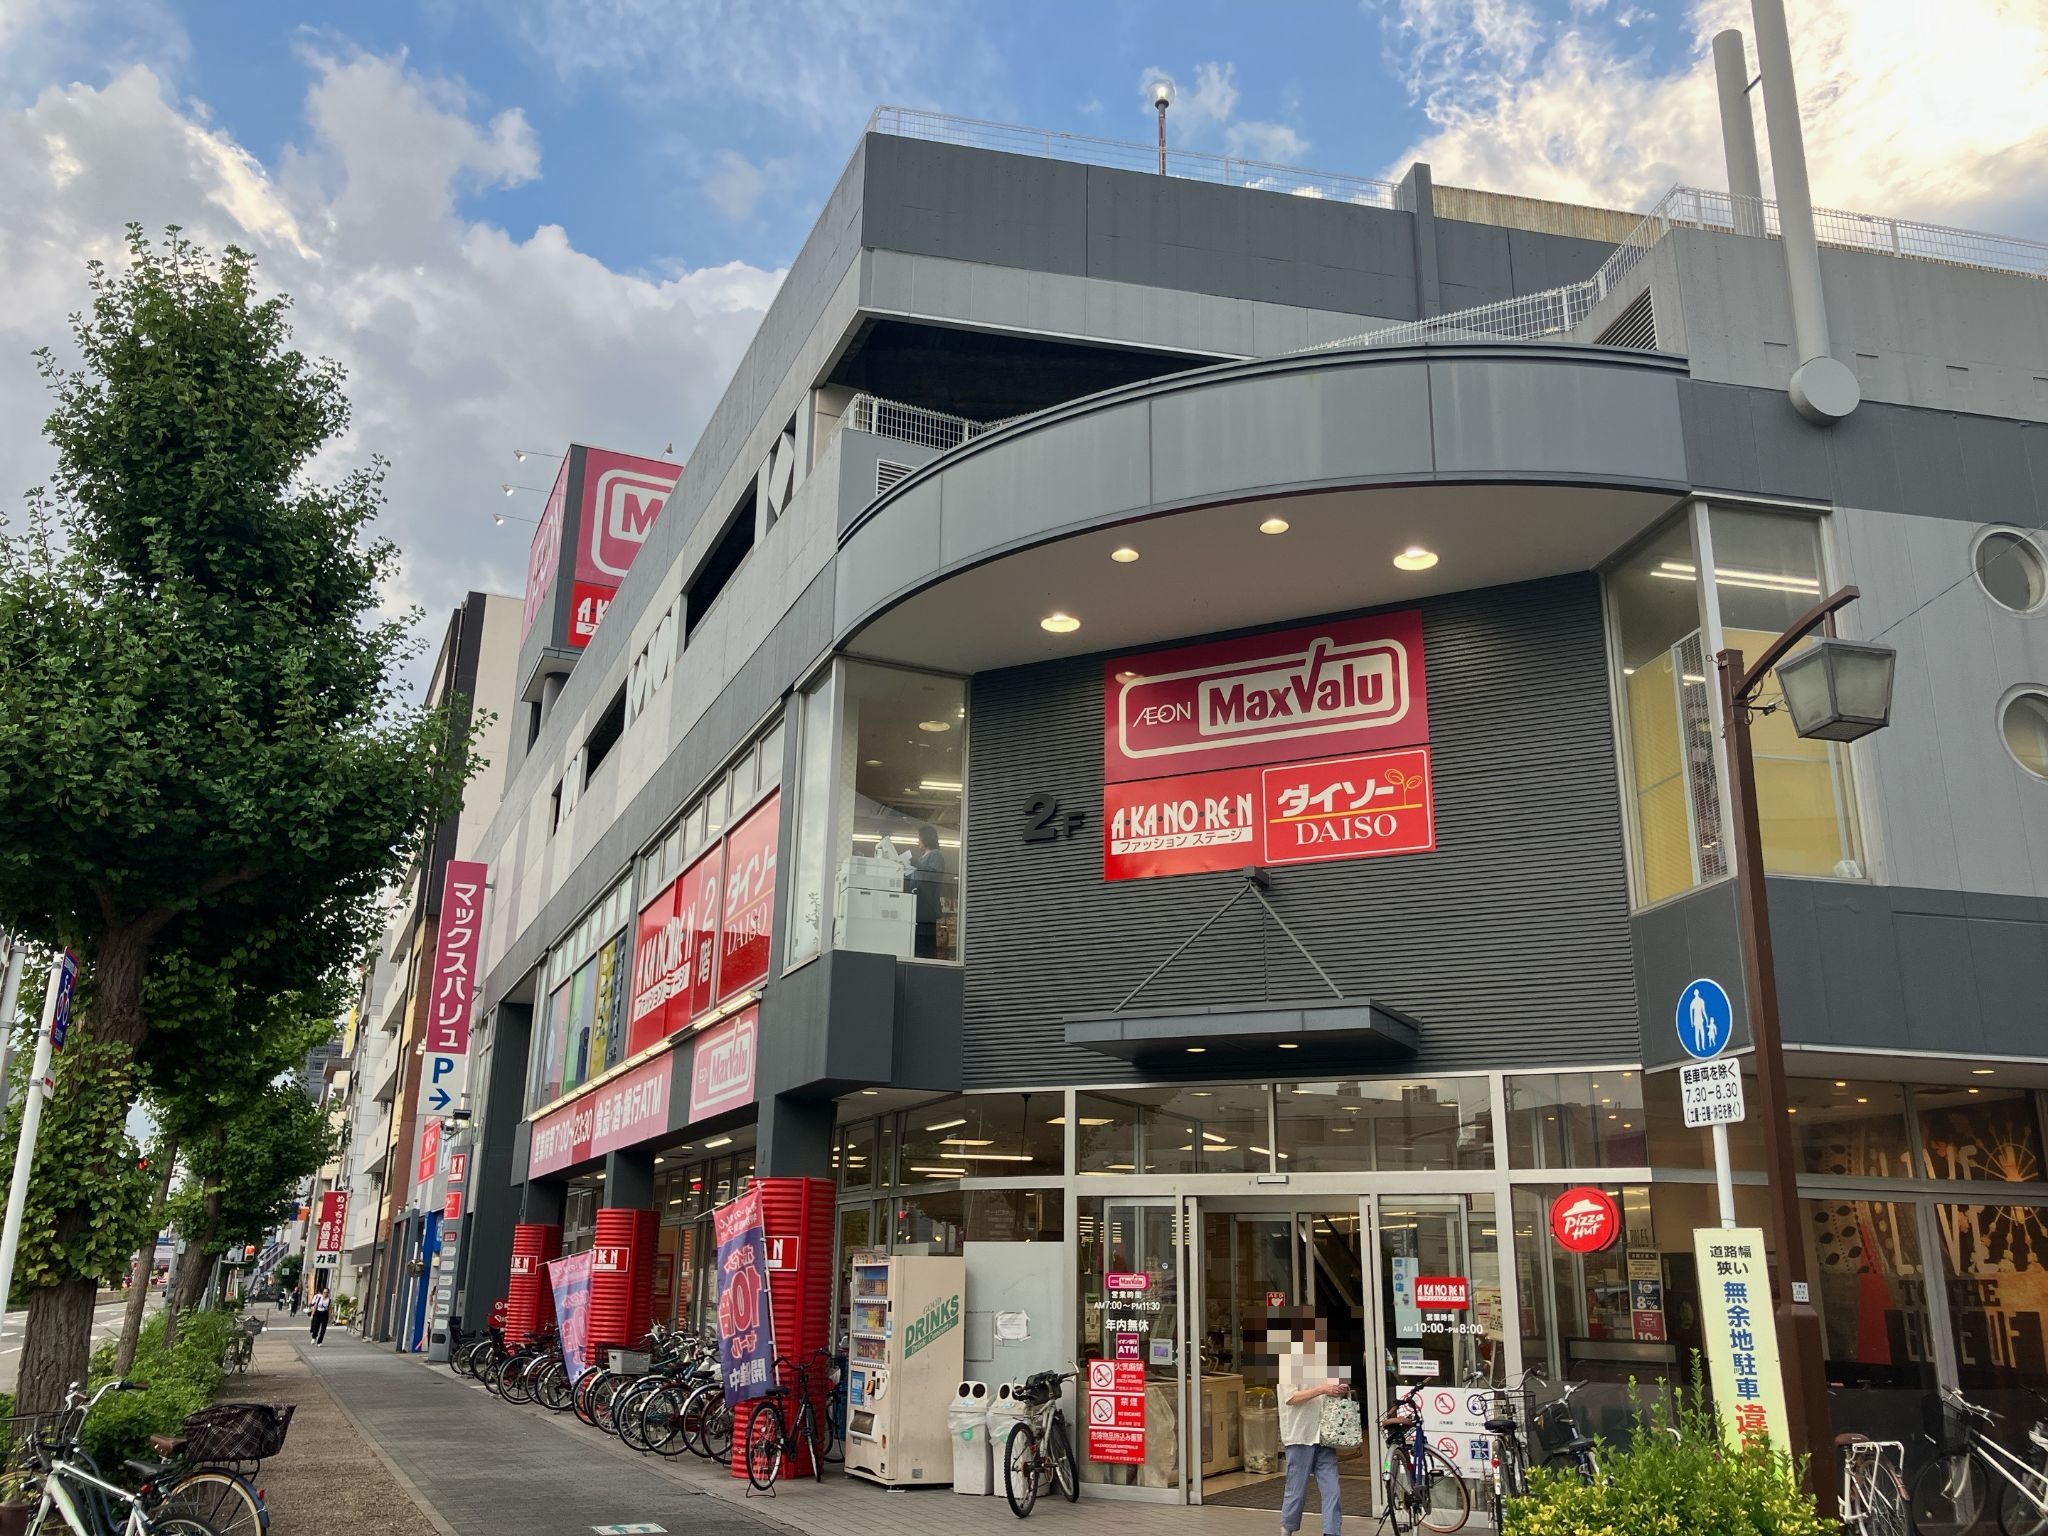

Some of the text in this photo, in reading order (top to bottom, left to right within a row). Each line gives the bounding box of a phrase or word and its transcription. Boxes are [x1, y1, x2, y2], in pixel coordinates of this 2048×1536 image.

[1208, 645, 1383, 727] MaxValu
[1277, 777, 1395, 817] ダイソー
[1119, 828, 1243, 853] ファッション ステージ
[1294, 814, 1398, 846] DAISO
[726, 901, 768, 957] DAISO
[437, 881, 478, 1048] マックスバリュ
[433, 1056, 455, 1084] P
[711, 1030, 748, 1088] MaxValu
[1683, 1062, 1736, 1085] 軽車両を除く
[1564, 1212, 1606, 1235] Pizza
[1572, 1223, 1603, 1241] Hut
[1709, 1245, 1752, 1259] 道路幅
[1716, 1261, 1749, 1276] 狭い
[1111, 1290, 1142, 1299] 営業時間
[1636, 1296, 1658, 1309] 8%
[905, 1294, 960, 1348] DRINKS
[1105, 1318, 1150, 1332] 年内無休
[1117, 1345, 1138, 1354] ATM
